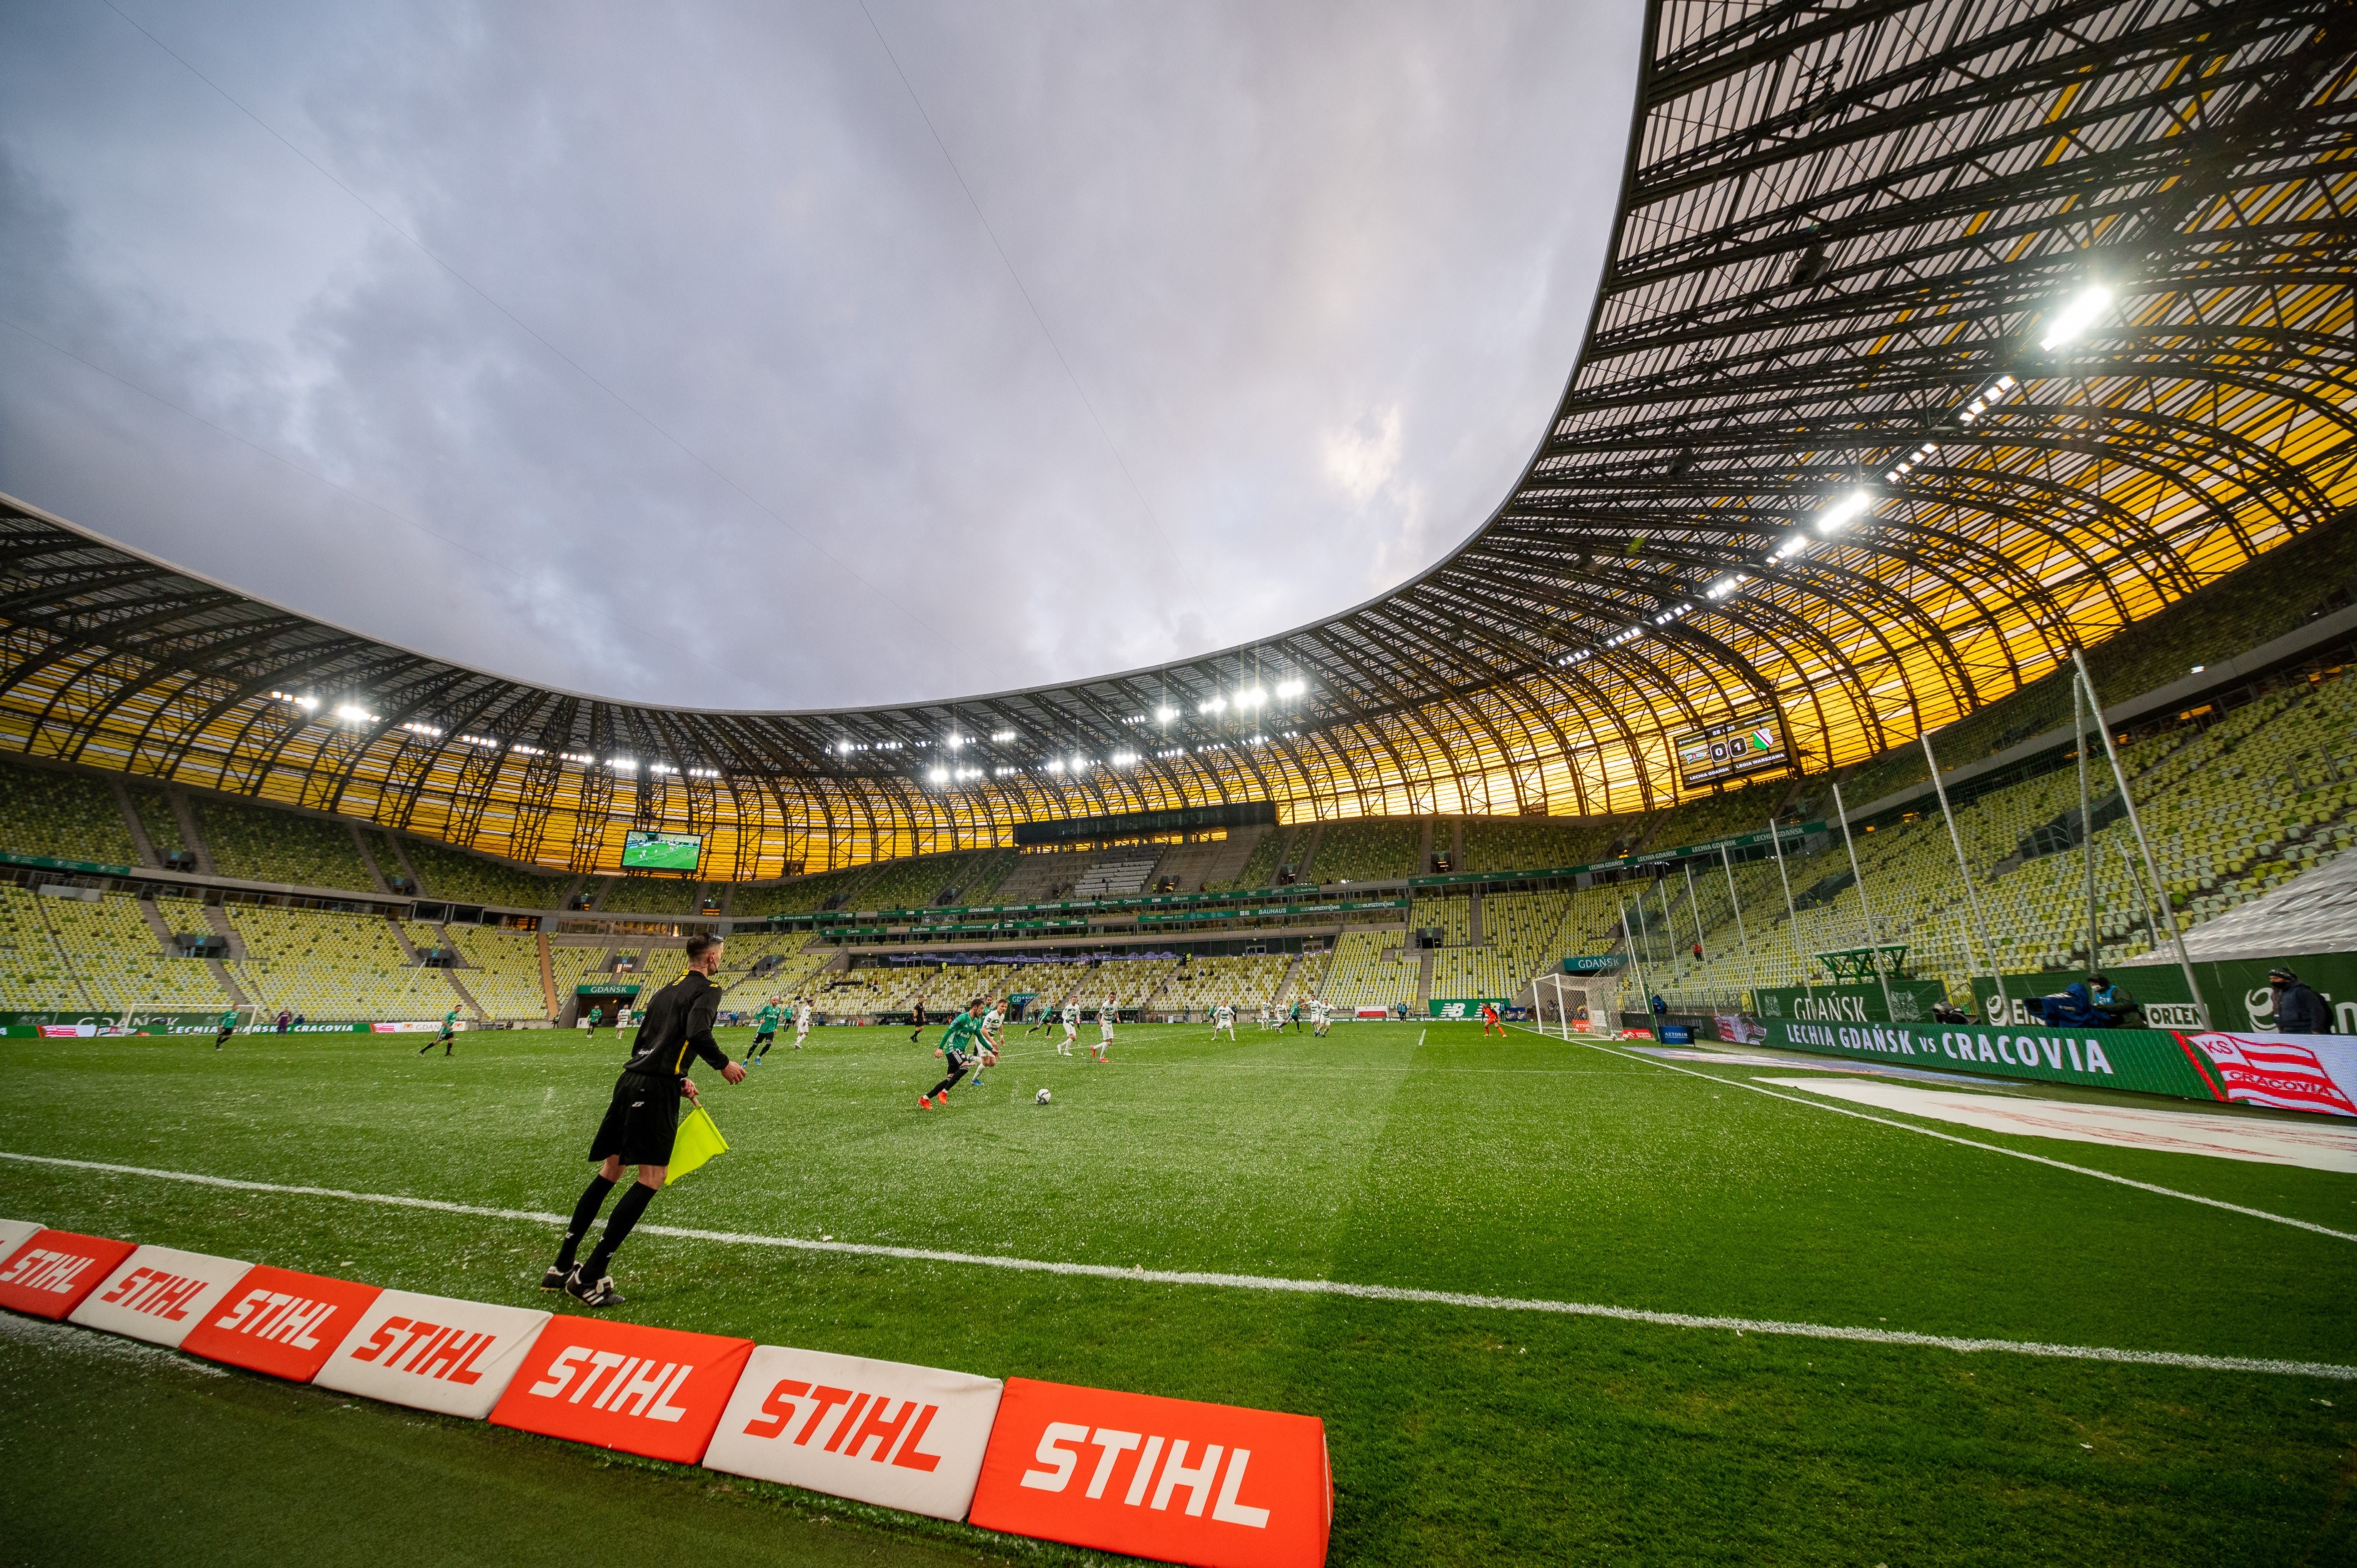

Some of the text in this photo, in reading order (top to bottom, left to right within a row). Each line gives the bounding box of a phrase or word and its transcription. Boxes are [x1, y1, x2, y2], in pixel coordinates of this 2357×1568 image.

[1715, 742, 1742, 757] 0 1
[1736, 753, 1785, 769] LEGIA WARSZAWA
[1689, 766, 1730, 780] LECHIA GDAŃSK
[1655, 850, 1677, 860] GDAŃSK
[1691, 844, 1711, 853] LECHIA
[1605, 859, 1625, 868] GDAŃSK
[294, 1024, 354, 1032] CRACOVIA
[1786, 1023, 2114, 1075] LECHIA GDAŃSK vs CRACOVIA
[2201, 1040, 2233, 1055] KS
[2229, 1071, 2332, 1097] CRACOVIA
[2, 1249, 94, 1294] STIHL
[100, 1266, 210, 1322] STIHL
[214, 1288, 338, 1350] STIHL
[350, 1316, 497, 1385] STIHL
[528, 1345, 695, 1422] STIHL
[743, 1379, 942, 1472] STIHL
[1020, 1421, 1271, 1529] STIHL
